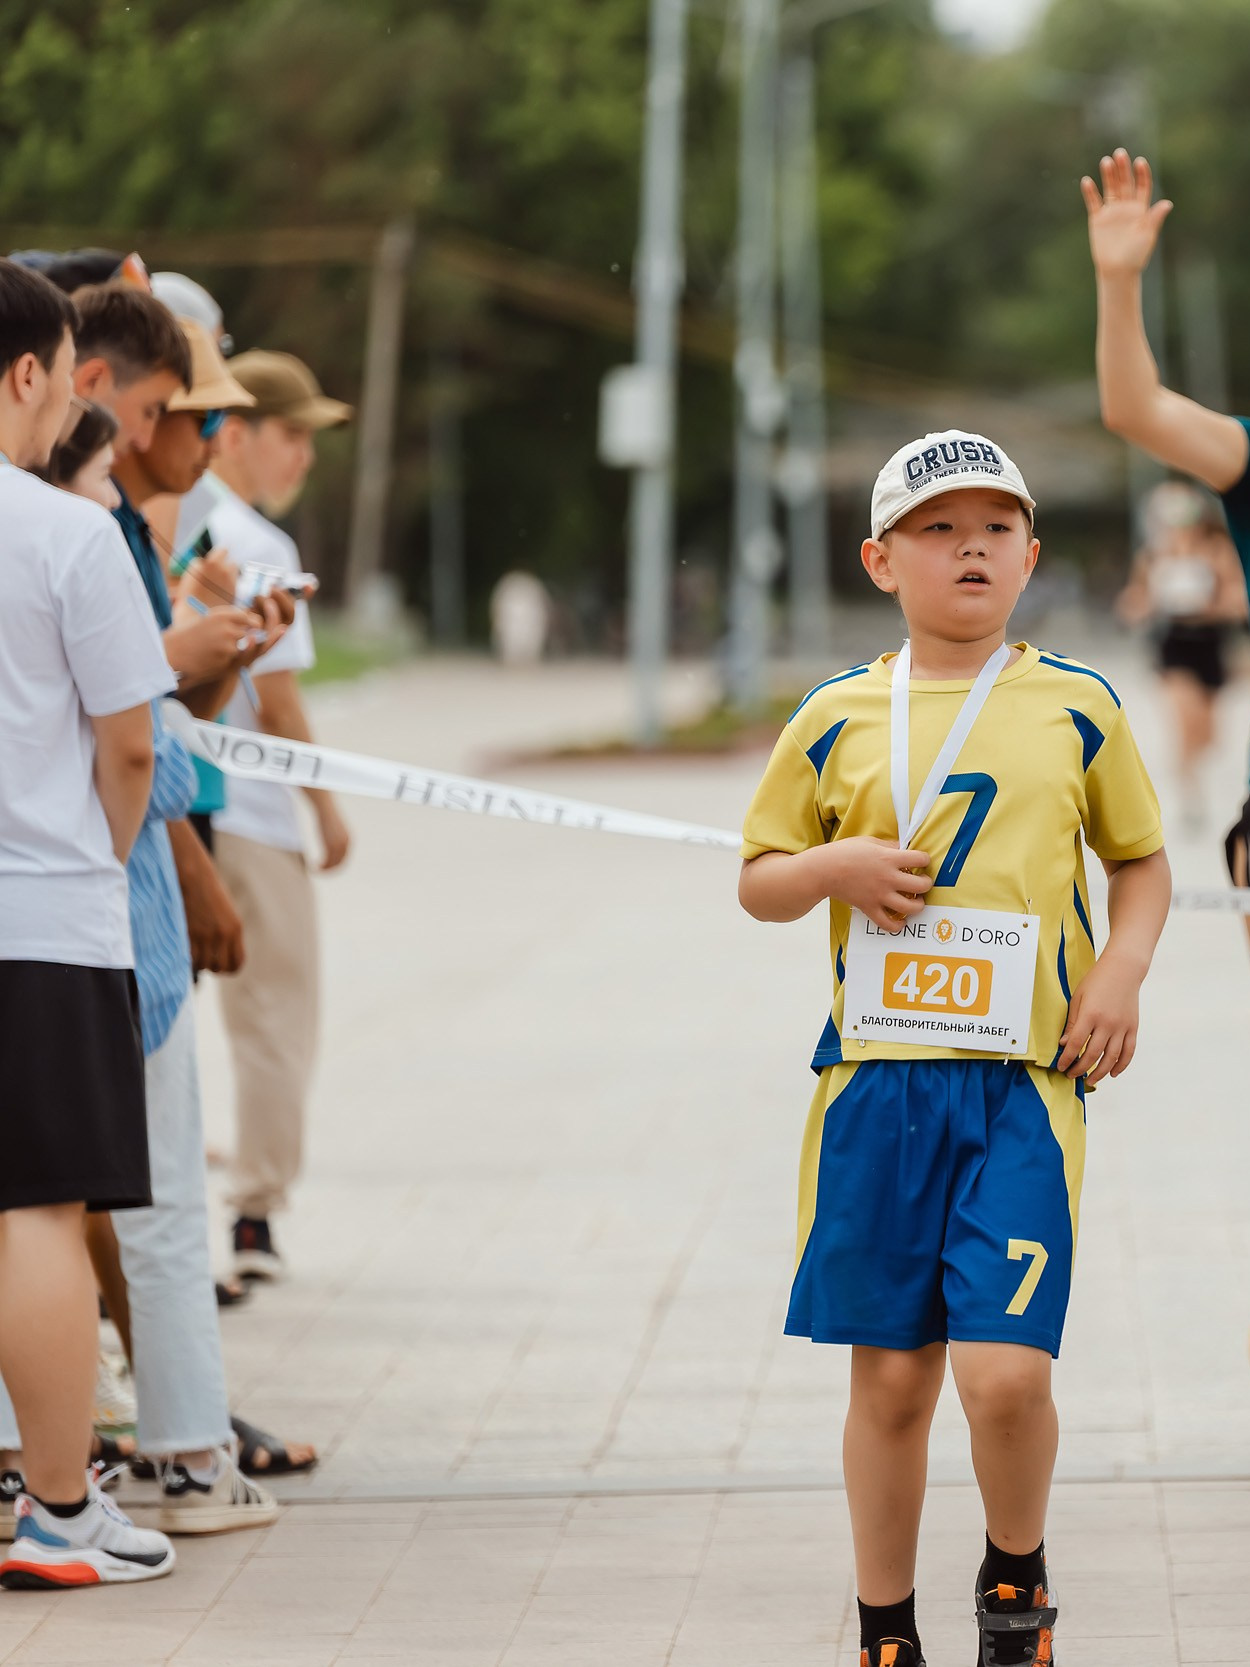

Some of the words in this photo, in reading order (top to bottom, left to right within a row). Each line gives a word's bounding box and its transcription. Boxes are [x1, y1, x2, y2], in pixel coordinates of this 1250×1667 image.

[906, 441, 1000, 480] CRUSH
[910, 477, 933, 492] CAUSE
[934, 468, 960, 480] THERE
[933, 772, 998, 887] 7
[962, 927, 1020, 946] D'ORO
[892, 961, 980, 1008] 420
[861, 1015, 975, 1034] БЛАГОТВОРИТЕЛЬНЫЙ
[977, 1025, 1010, 1037] ЗАБЕГ
[1005, 1238, 1049, 1315] 7
